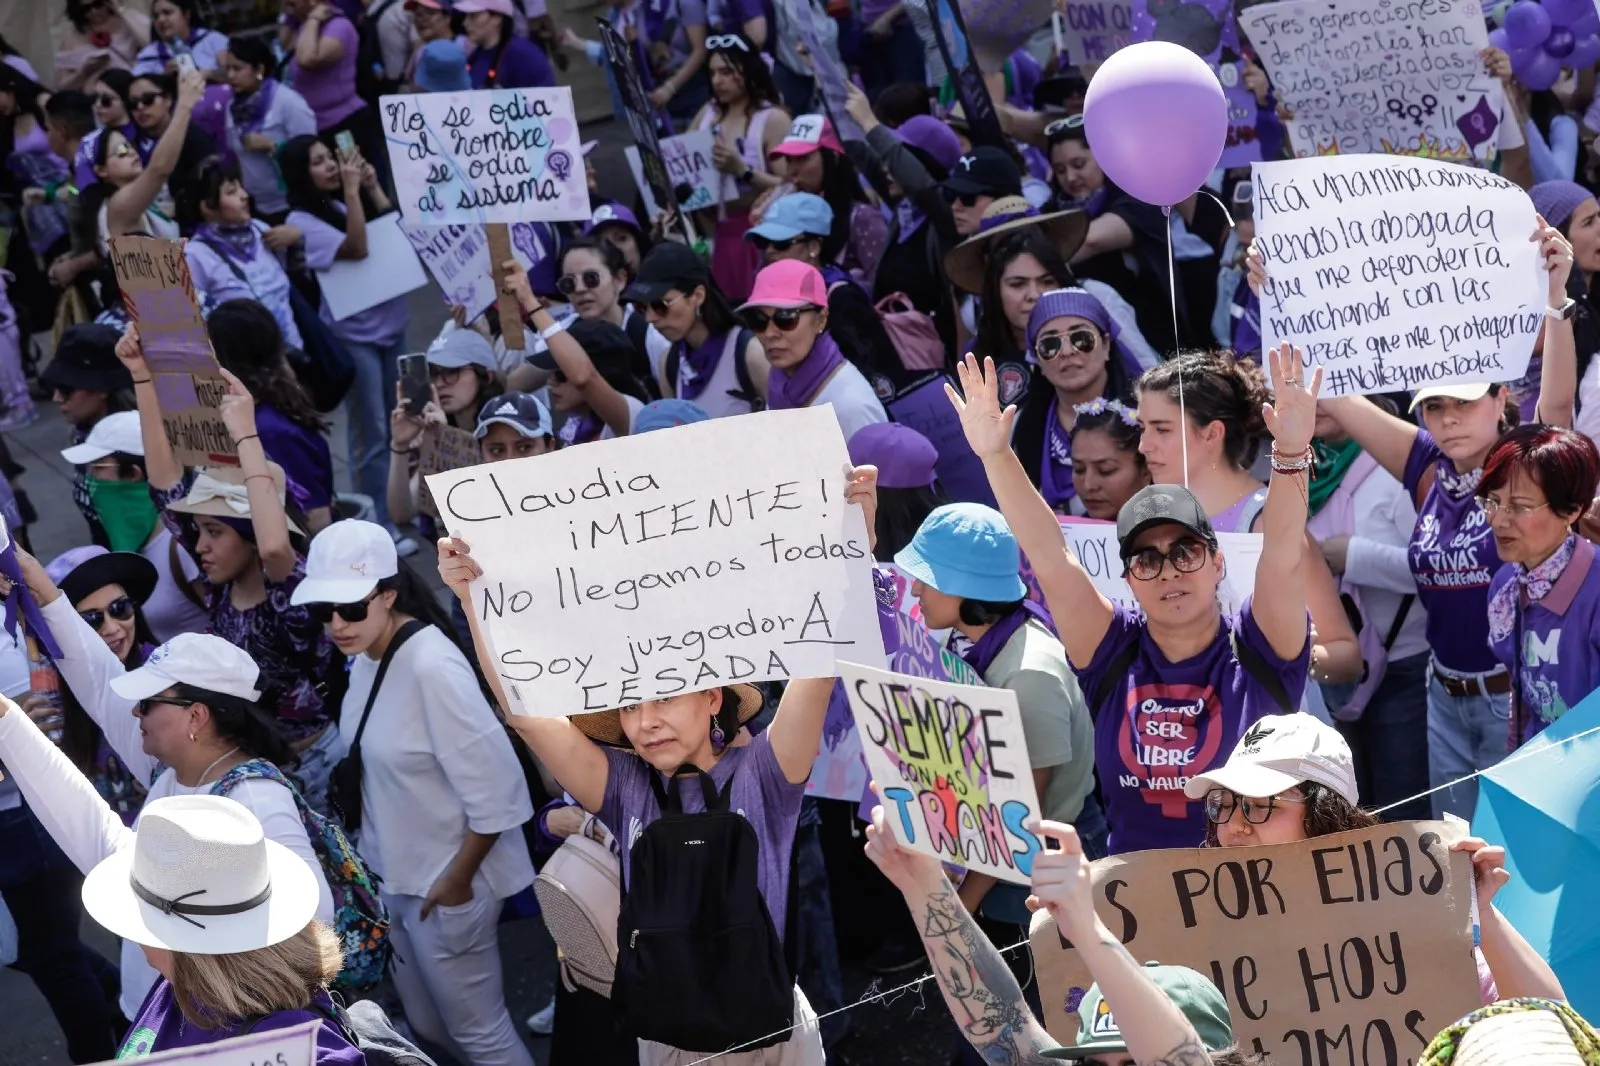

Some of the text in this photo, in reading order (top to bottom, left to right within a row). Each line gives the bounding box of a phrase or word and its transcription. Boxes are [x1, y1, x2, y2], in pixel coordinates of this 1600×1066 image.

[1251, 0, 1451, 41] Tres generaciones
[1417, 26, 1473, 48] han
[386, 93, 552, 133] No se odia
[1337, 86, 1379, 115] hoy
[408, 132, 437, 160] al
[425, 151, 531, 184] se odia
[419, 178, 560, 212] al sistema
[1257, 173, 1310, 220] Acá
[1371, 205, 1499, 248] abogada
[1315, 264, 1350, 289] me
[1403, 281, 1443, 309] con
[1452, 276, 1491, 305] las
[1405, 325, 1436, 350] me
[445, 467, 660, 522] Claudia
[481, 581, 534, 621] No
[556, 553, 746, 611] llegamos
[1434, 567, 1491, 586] QUEREMOS
[896, 611, 934, 664] NOS
[500, 648, 594, 684] Soy
[583, 649, 792, 712] CESADA
[855, 678, 1016, 780] SIEMPRE
[1145, 720, 1188, 739] SER
[1136, 743, 1196, 767] LIBRE
[899, 760, 969, 796] CON LAS
[1119, 774, 1139, 788] NO
[883, 786, 1044, 878] TRANS
[1172, 857, 1286, 929] POR
[1298, 931, 1408, 1013] HOY
